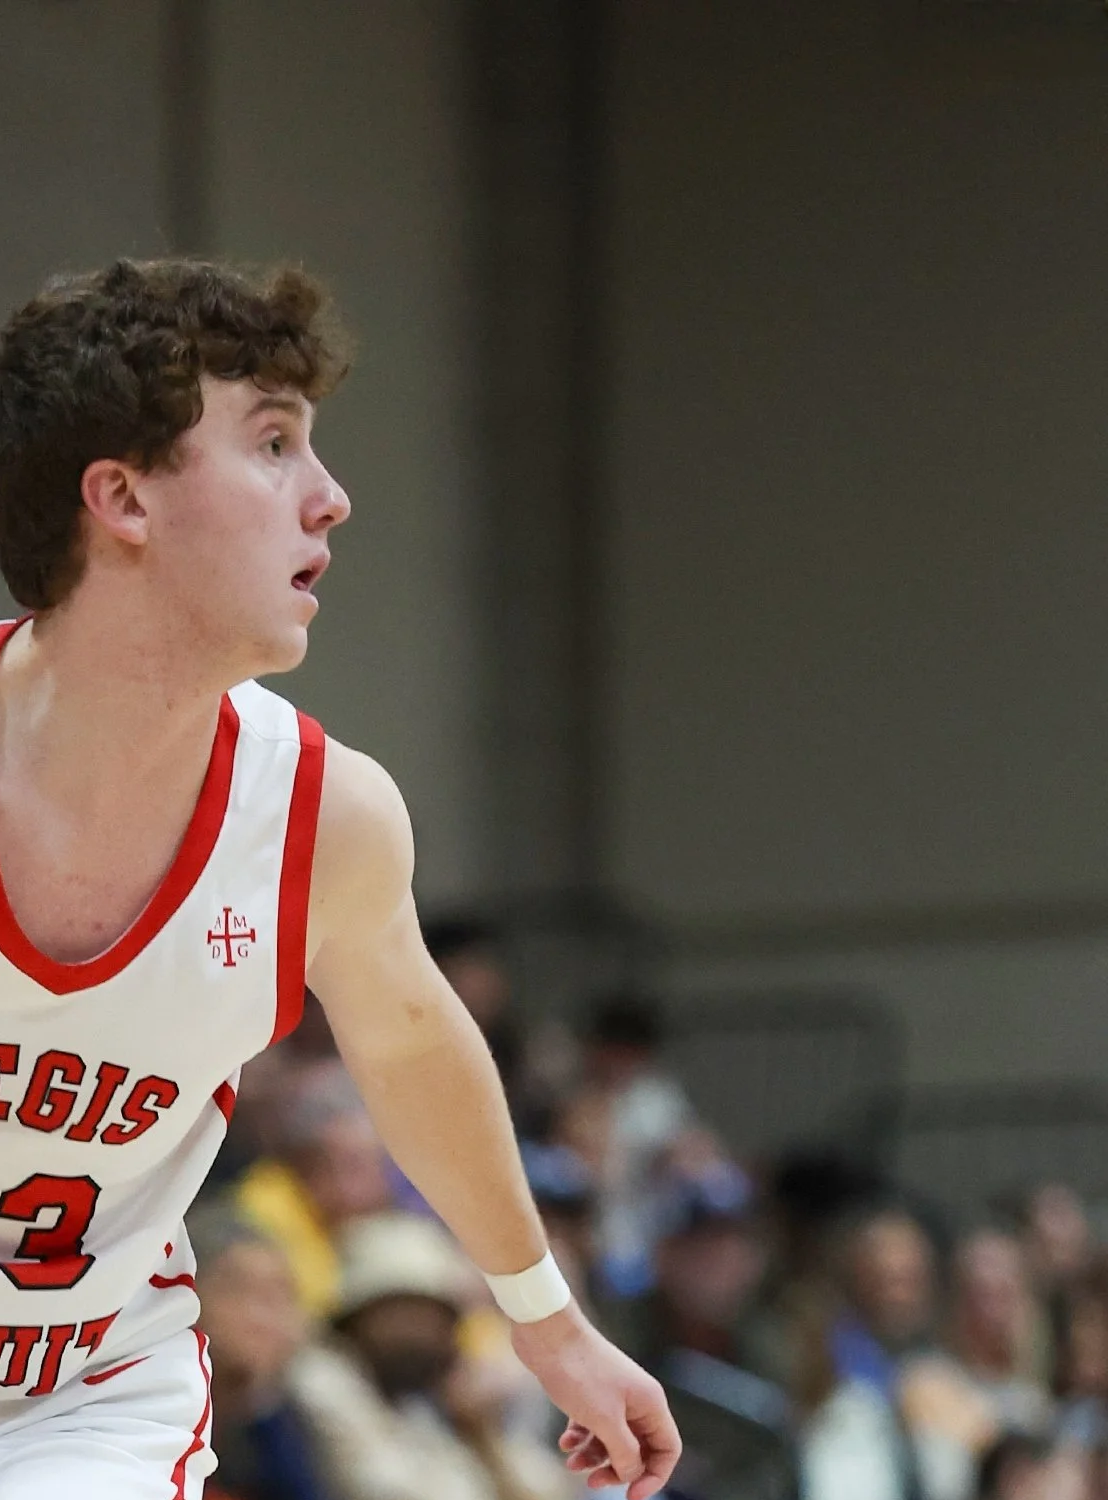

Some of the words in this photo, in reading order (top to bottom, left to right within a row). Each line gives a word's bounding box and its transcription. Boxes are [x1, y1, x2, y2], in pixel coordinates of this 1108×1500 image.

[233, 915, 247, 929] M
[212, 944, 221, 959] D
[237, 943, 249, 958] G
